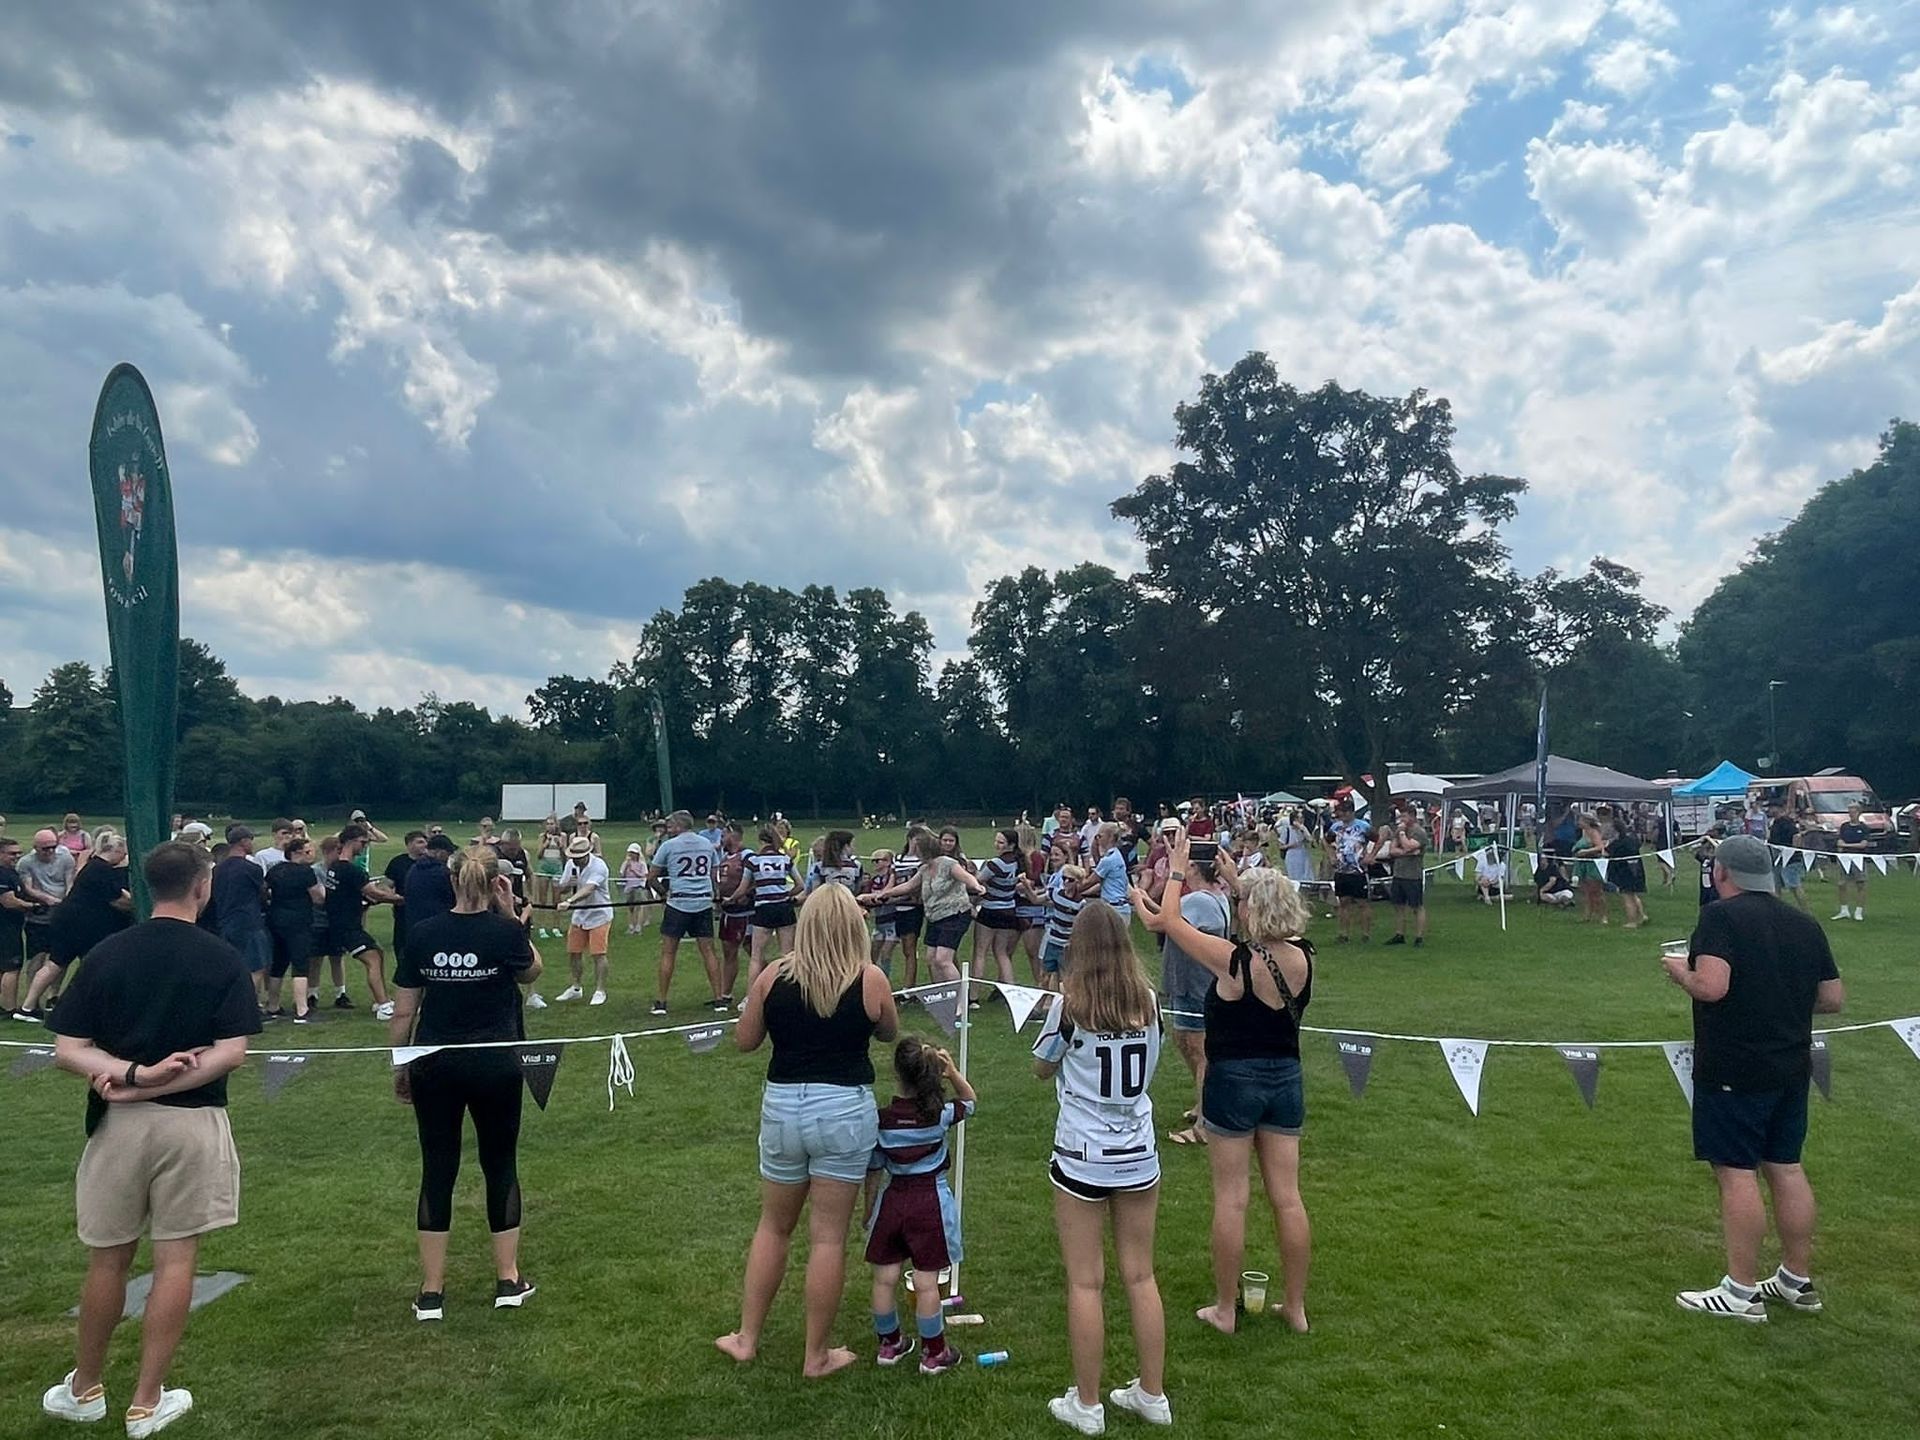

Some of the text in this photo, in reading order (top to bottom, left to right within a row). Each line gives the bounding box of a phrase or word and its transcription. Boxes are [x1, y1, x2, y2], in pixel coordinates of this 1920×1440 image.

[677, 856, 708, 877] 28
[451, 967, 498, 977] REPUBLIC
[1095, 1043, 1147, 1098] 10
